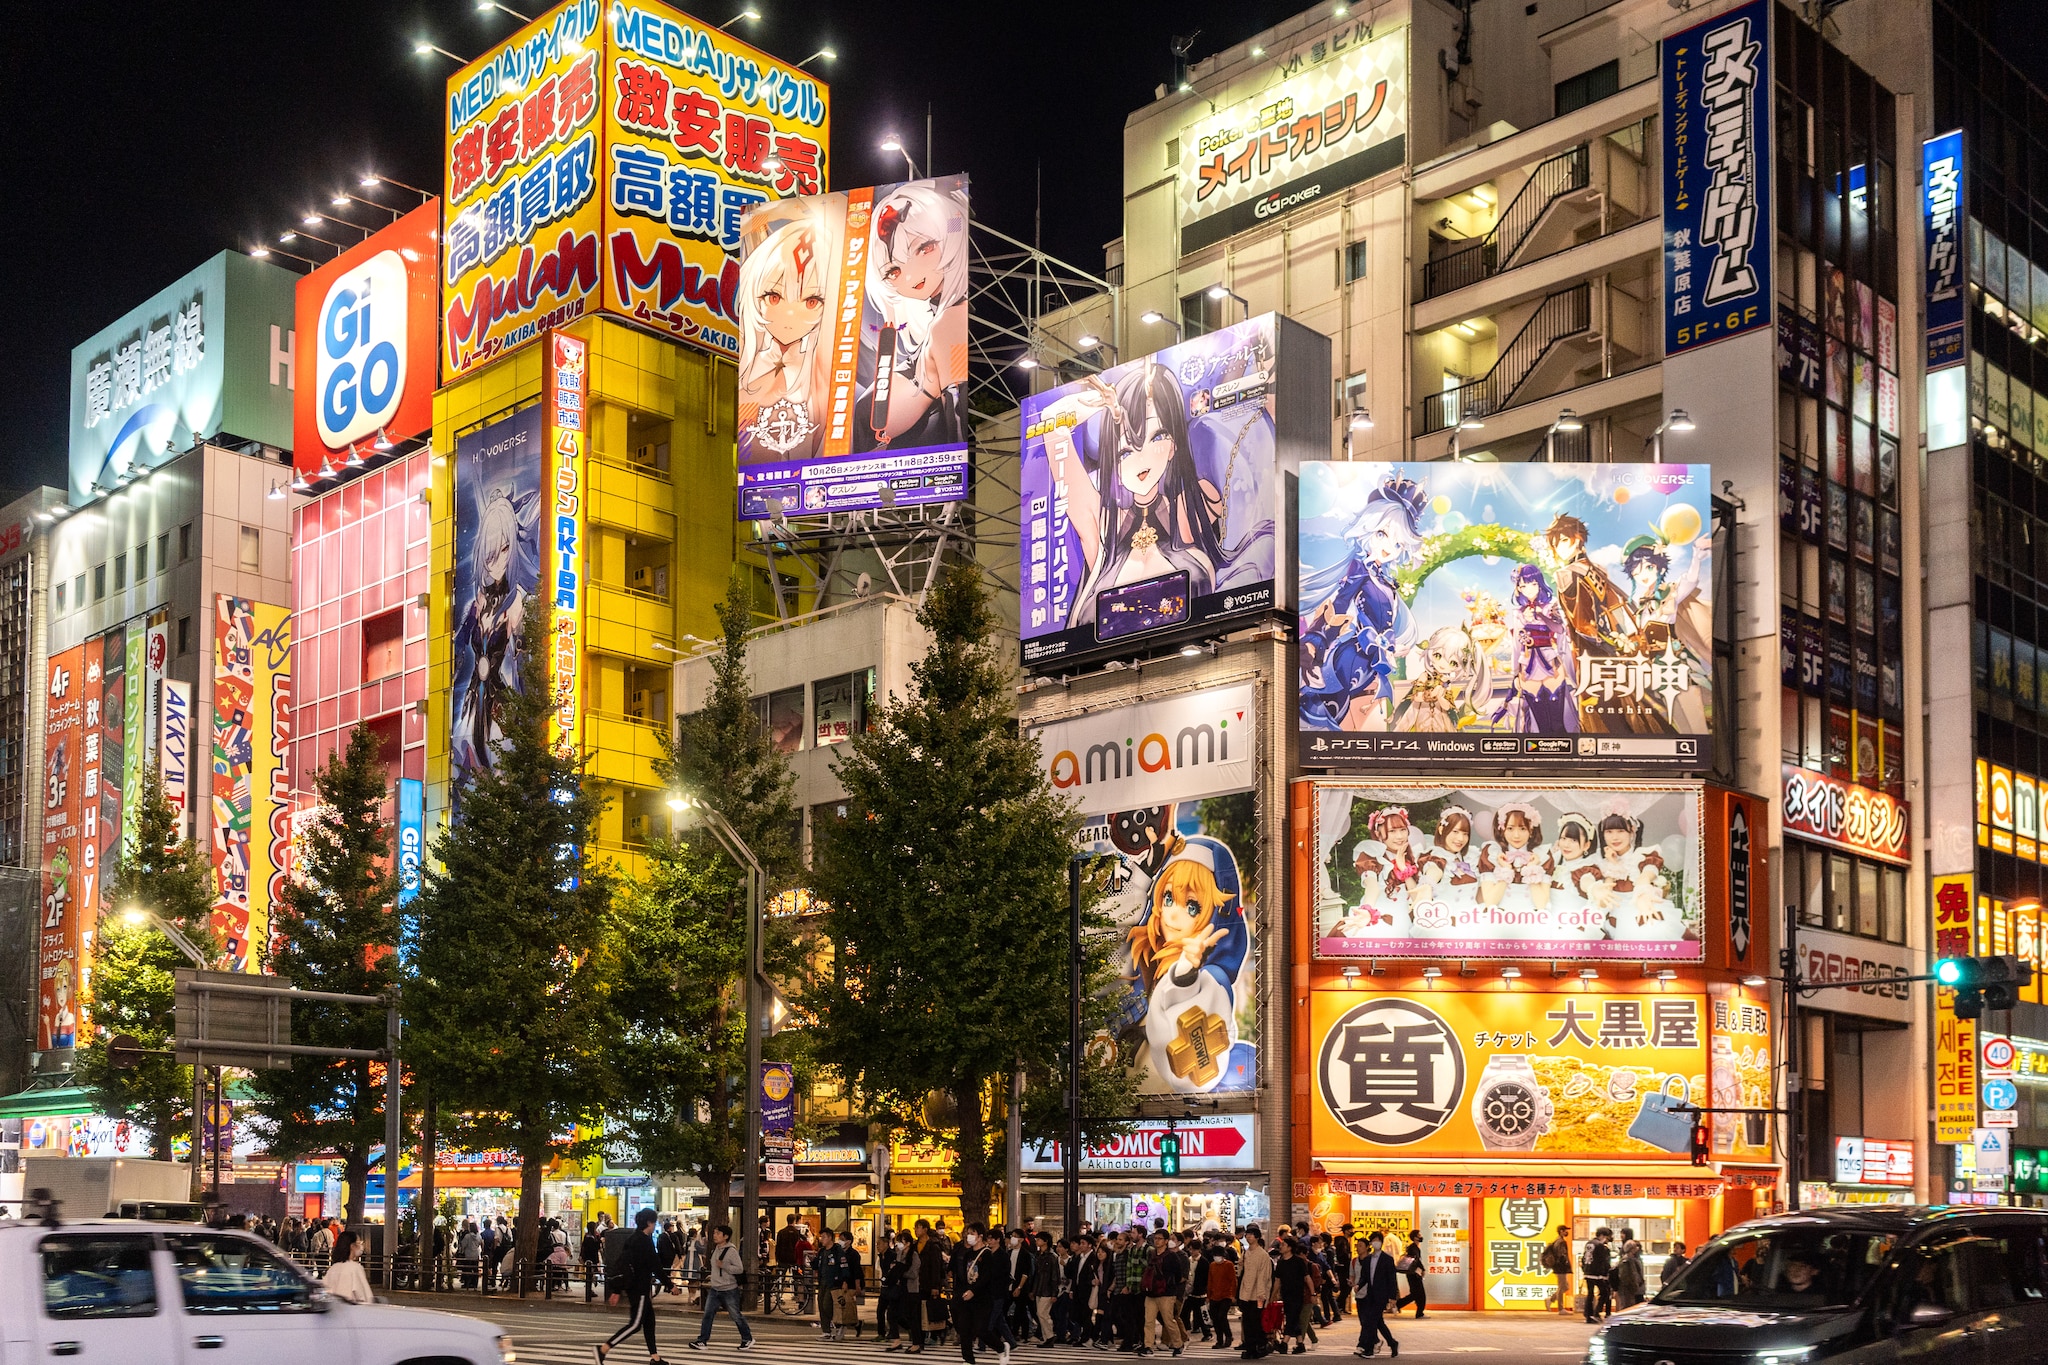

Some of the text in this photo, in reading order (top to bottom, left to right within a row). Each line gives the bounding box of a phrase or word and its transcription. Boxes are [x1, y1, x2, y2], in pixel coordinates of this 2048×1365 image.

[451, 0, 600, 133] MEDIAリサイクル
[613, 6, 822, 125] MEDIAリサイクル
[451, 52, 595, 202] 激安販売
[615, 60, 820, 198] 激安販売
[1197, 79, 1388, 202] メイドカジノ
[1674, 59, 1689, 202] トレーディングカードゲーム
[448, 138, 593, 284] 高額買取
[1674, 228, 1692, 316] 秋葉原店
[446, 230, 600, 368] Mulan
[634, 300, 700, 337] ムーラン
[461, 337, 503, 370] ムーラン
[503, 322, 536, 349] AKIBA
[1208, 343, 1267, 377] アズールレーン
[323, 341, 399, 433] GO
[558, 372, 579, 388] 買取
[1215, 381, 1241, 394] アズレン
[1799, 352, 1820, 389] 7F
[558, 391, 579, 407] 販売
[557, 409, 581, 429] 市場
[756, 470, 792, 482] 登場期間
[831, 485, 858, 496] アズレン
[940, 486, 964, 495] YOSTAR
[556, 430, 579, 609] ムーラン AKIBA
[1053, 440, 1070, 623] ゴールデン・ハインド
[1234, 589, 1270, 609] YOSTAR
[50, 665, 70, 698] 4F
[1574, 637, 1690, 725] 原神
[1802, 651, 1823, 686] 5F
[49, 698, 81, 720] カードゲーム
[165, 684, 186, 769] AKKY
[1585, 705, 1653, 715] Genshin
[1050, 719, 1229, 789] amiami
[1427, 740, 1476, 752] Windows
[1538, 740, 1570, 749] Google Play
[1601, 741, 1621, 752] 原神
[48, 774, 67, 809] 3F
[83, 698, 100, 909] 秋葉原 Hey
[1991, 771, 2048, 836] am
[1786, 777, 1906, 850] メイドカジノ
[1078, 826, 1109, 843] GEAR
[45, 894, 64, 929] 2F
[1557, 908, 1604, 926] cafe
[1936, 883, 1971, 960] 免税
[43, 947, 75, 964] レトロゲーム
[1810, 951, 1909, 1000] スマホ修理王
[1474, 1031, 1538, 1048] チケット
[1547, 1000, 1699, 1048] 大黒屋
[1190, 1025, 1210, 1070] GROWTH
[1958, 1032, 1974, 1096] FREE
[1991, 1047, 2009, 1060] 40
[1990, 1087, 2004, 1106] P
[1939, 1114, 1975, 1123] AKIHABARA
[807, 1149, 859, 1162] YOSHINOYA
[1088, 1159, 1152, 1169] Akihabara
[1330, 1178, 1719, 1197] 高価買取 無料査定
[1429, 1219, 1460, 1229] 大黒屋
[1428, 1266, 1461, 1274] 査定入口
